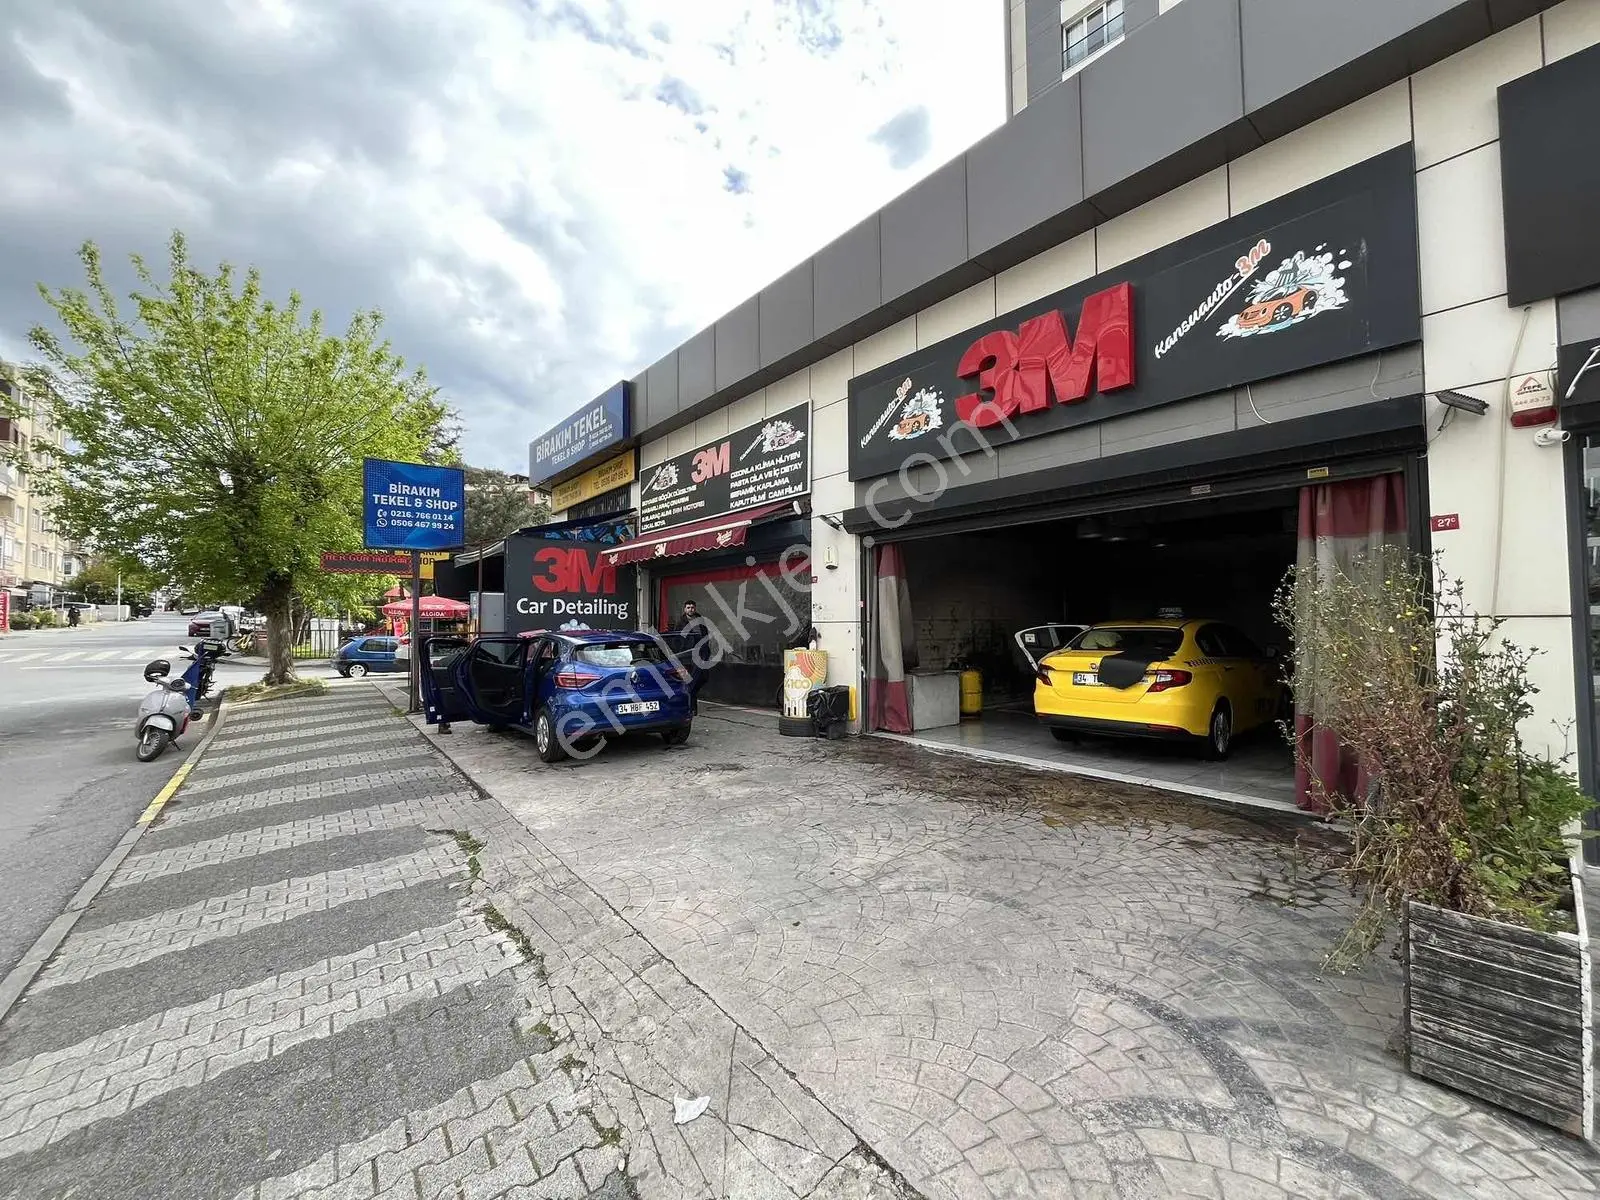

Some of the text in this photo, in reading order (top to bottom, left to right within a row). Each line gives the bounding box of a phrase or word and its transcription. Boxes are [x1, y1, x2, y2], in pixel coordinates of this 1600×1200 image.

[955, 281, 1136, 428] 3M
[573, 405, 606, 440] TEKEL
[570, 440, 585, 455] SHOP
[691, 441, 730, 483] 3M
[389, 482, 440, 497] BİRAKIM
[730, 477, 749, 489] PASTA
[756, 477, 789, 492] KAPLAMA
[372, 494, 458, 510] TEKEL & SHOP
[730, 498, 750, 509] KAPUT
[768, 488, 784, 499] CAM
[391, 519, 413, 527] 0506
[532, 547, 618, 594] 3M
[516, 597, 629, 620] Car Detailing
[619, 705, 628, 713] 34
